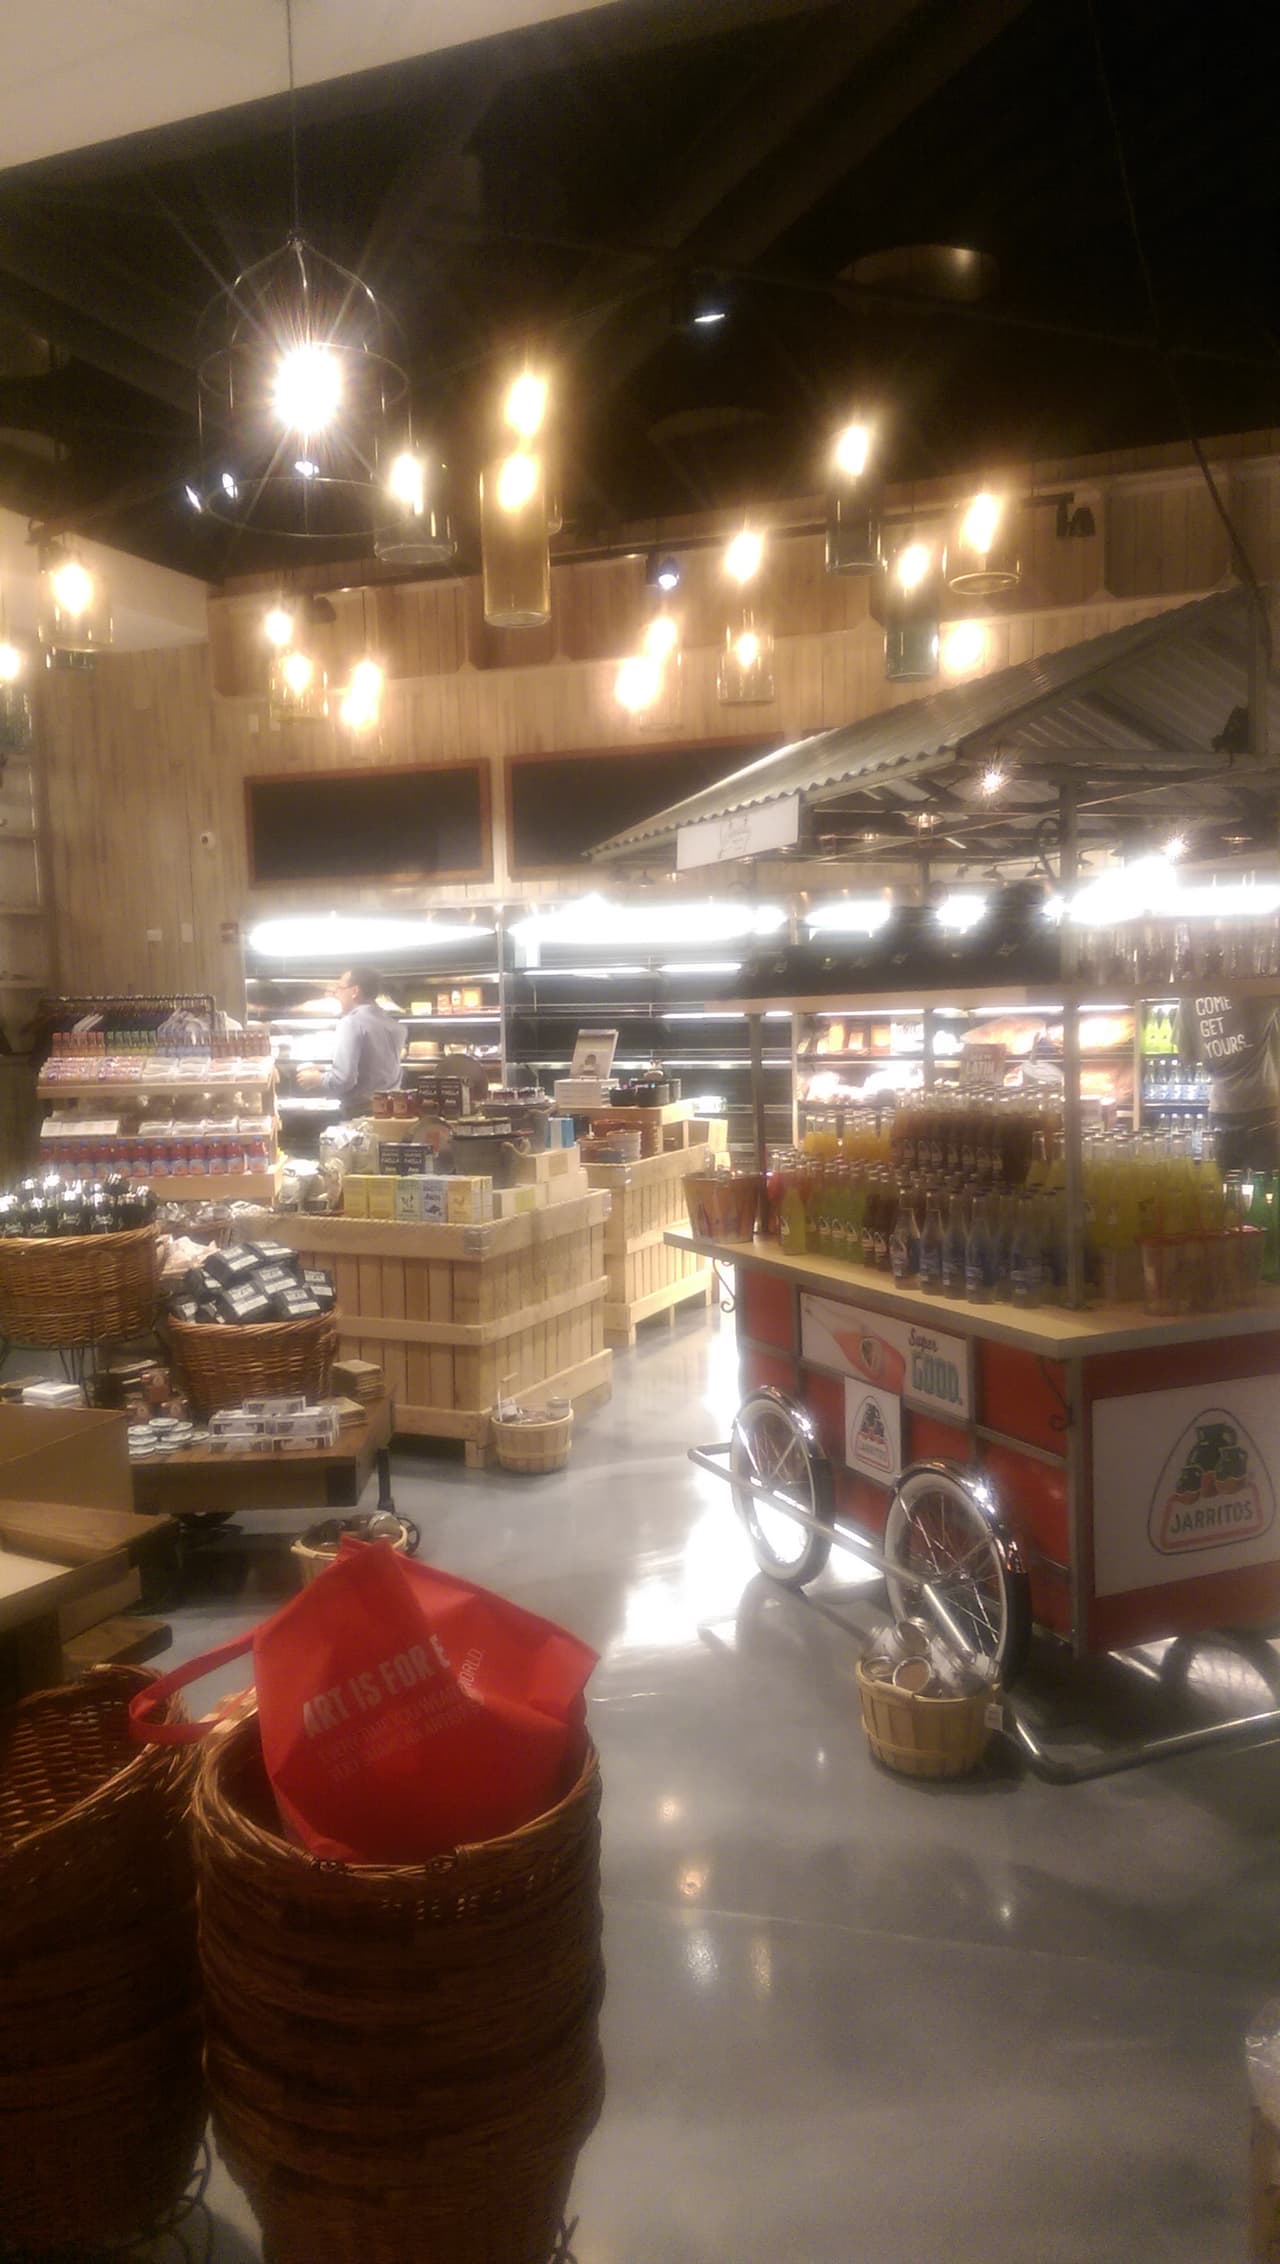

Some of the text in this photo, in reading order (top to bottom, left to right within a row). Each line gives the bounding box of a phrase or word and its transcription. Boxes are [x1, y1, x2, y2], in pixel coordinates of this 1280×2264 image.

[1195, 996, 1232, 1016] COME
[1200, 1016, 1225, 1037] GET
[908, 1327, 938, 1353] Super
[1170, 1500, 1253, 1534] JARRITOS
[303, 1685, 350, 1739] ART
[348, 1671, 382, 1712] IS
[379, 1645, 435, 1697] FOR
